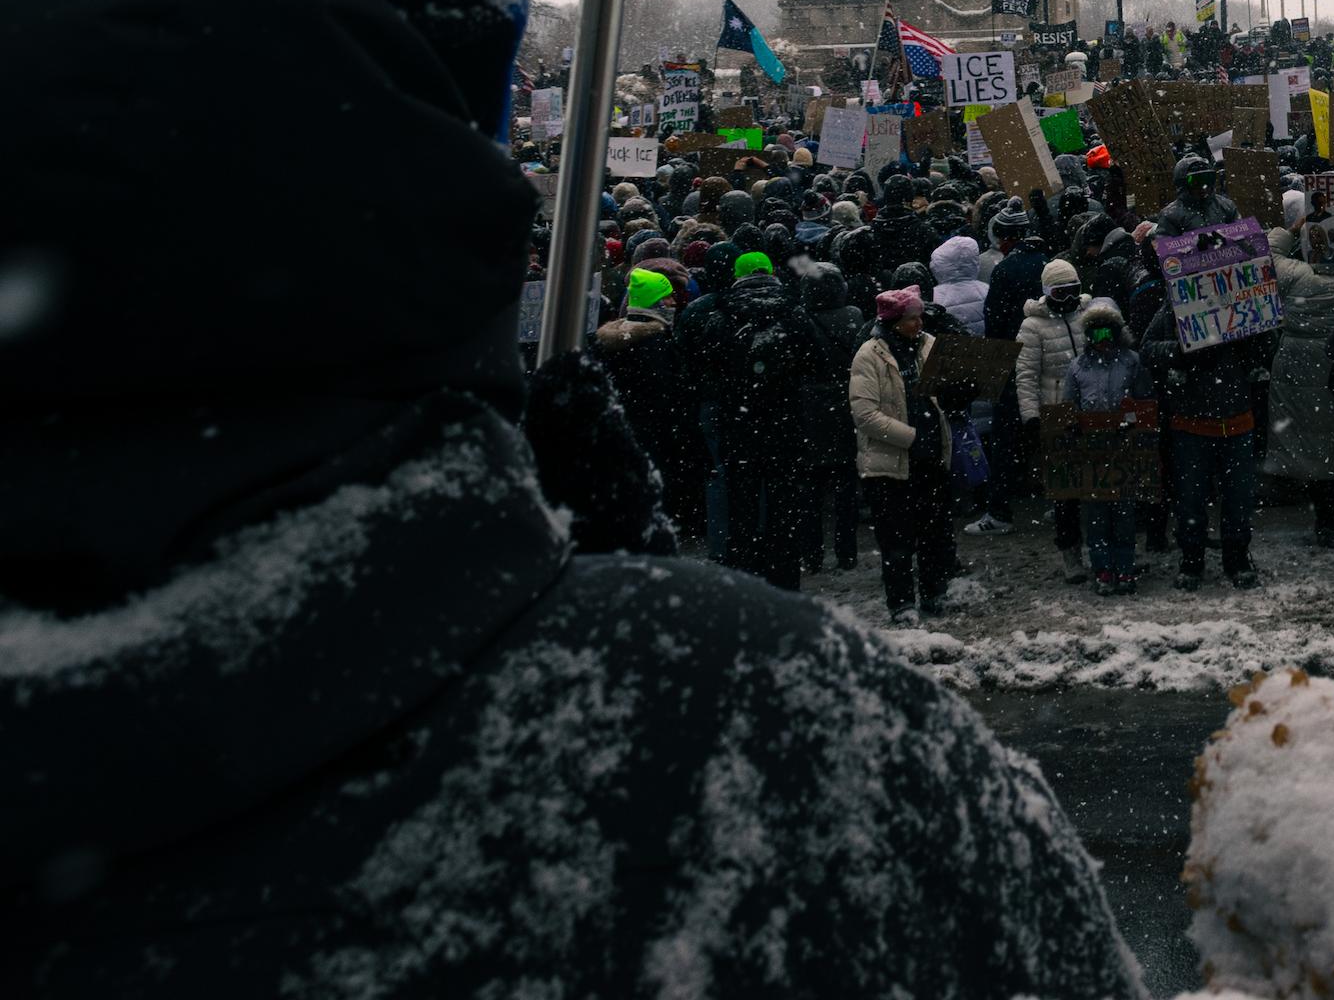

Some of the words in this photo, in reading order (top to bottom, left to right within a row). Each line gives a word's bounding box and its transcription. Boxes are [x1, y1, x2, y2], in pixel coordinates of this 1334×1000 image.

[1034, 30, 1074, 44] RESIST
[957, 55, 1004, 80] ICE
[951, 77, 1008, 103] LIES
[635, 147, 653, 163] ICE
[1206, 267, 1233, 296] THY
[1180, 308, 1222, 346] MATT
